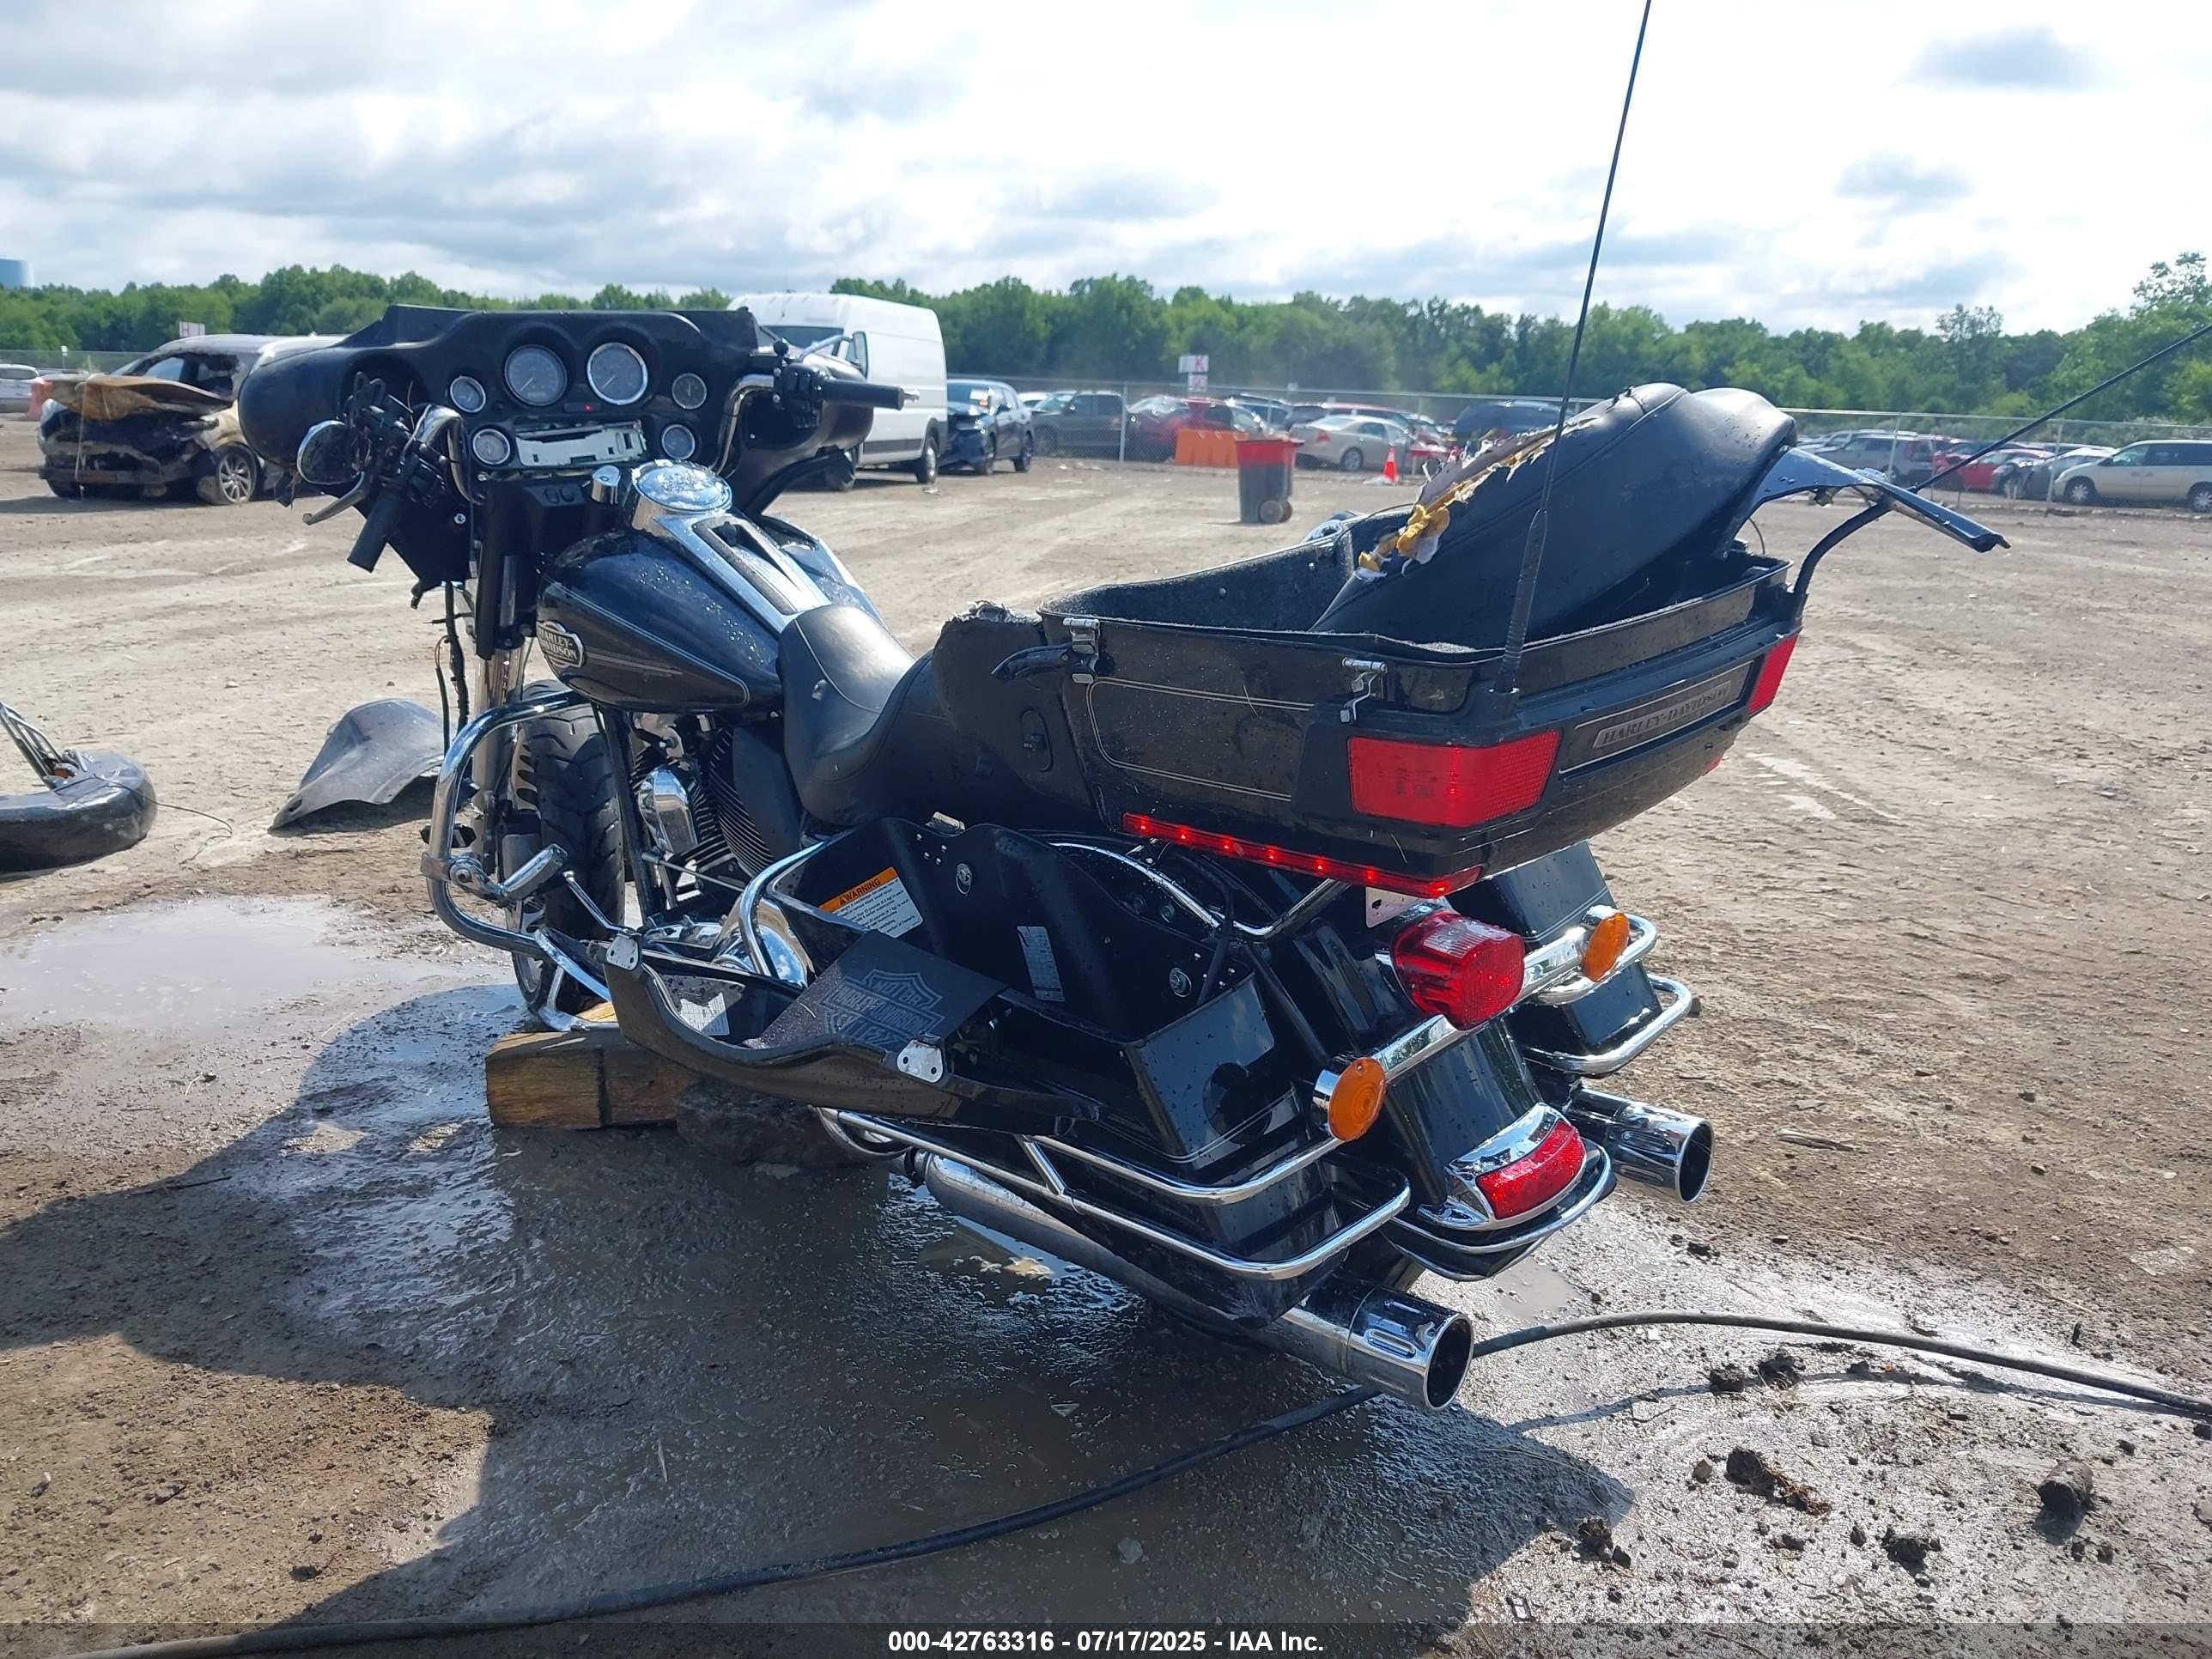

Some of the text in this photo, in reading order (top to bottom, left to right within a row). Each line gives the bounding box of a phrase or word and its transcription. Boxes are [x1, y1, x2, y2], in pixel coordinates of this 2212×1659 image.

[845, 878, 881, 902] WARNING
[872, 981, 922, 1007] MOTOR
[831, 985, 928, 1034] HARLEY-DAVIDSON
